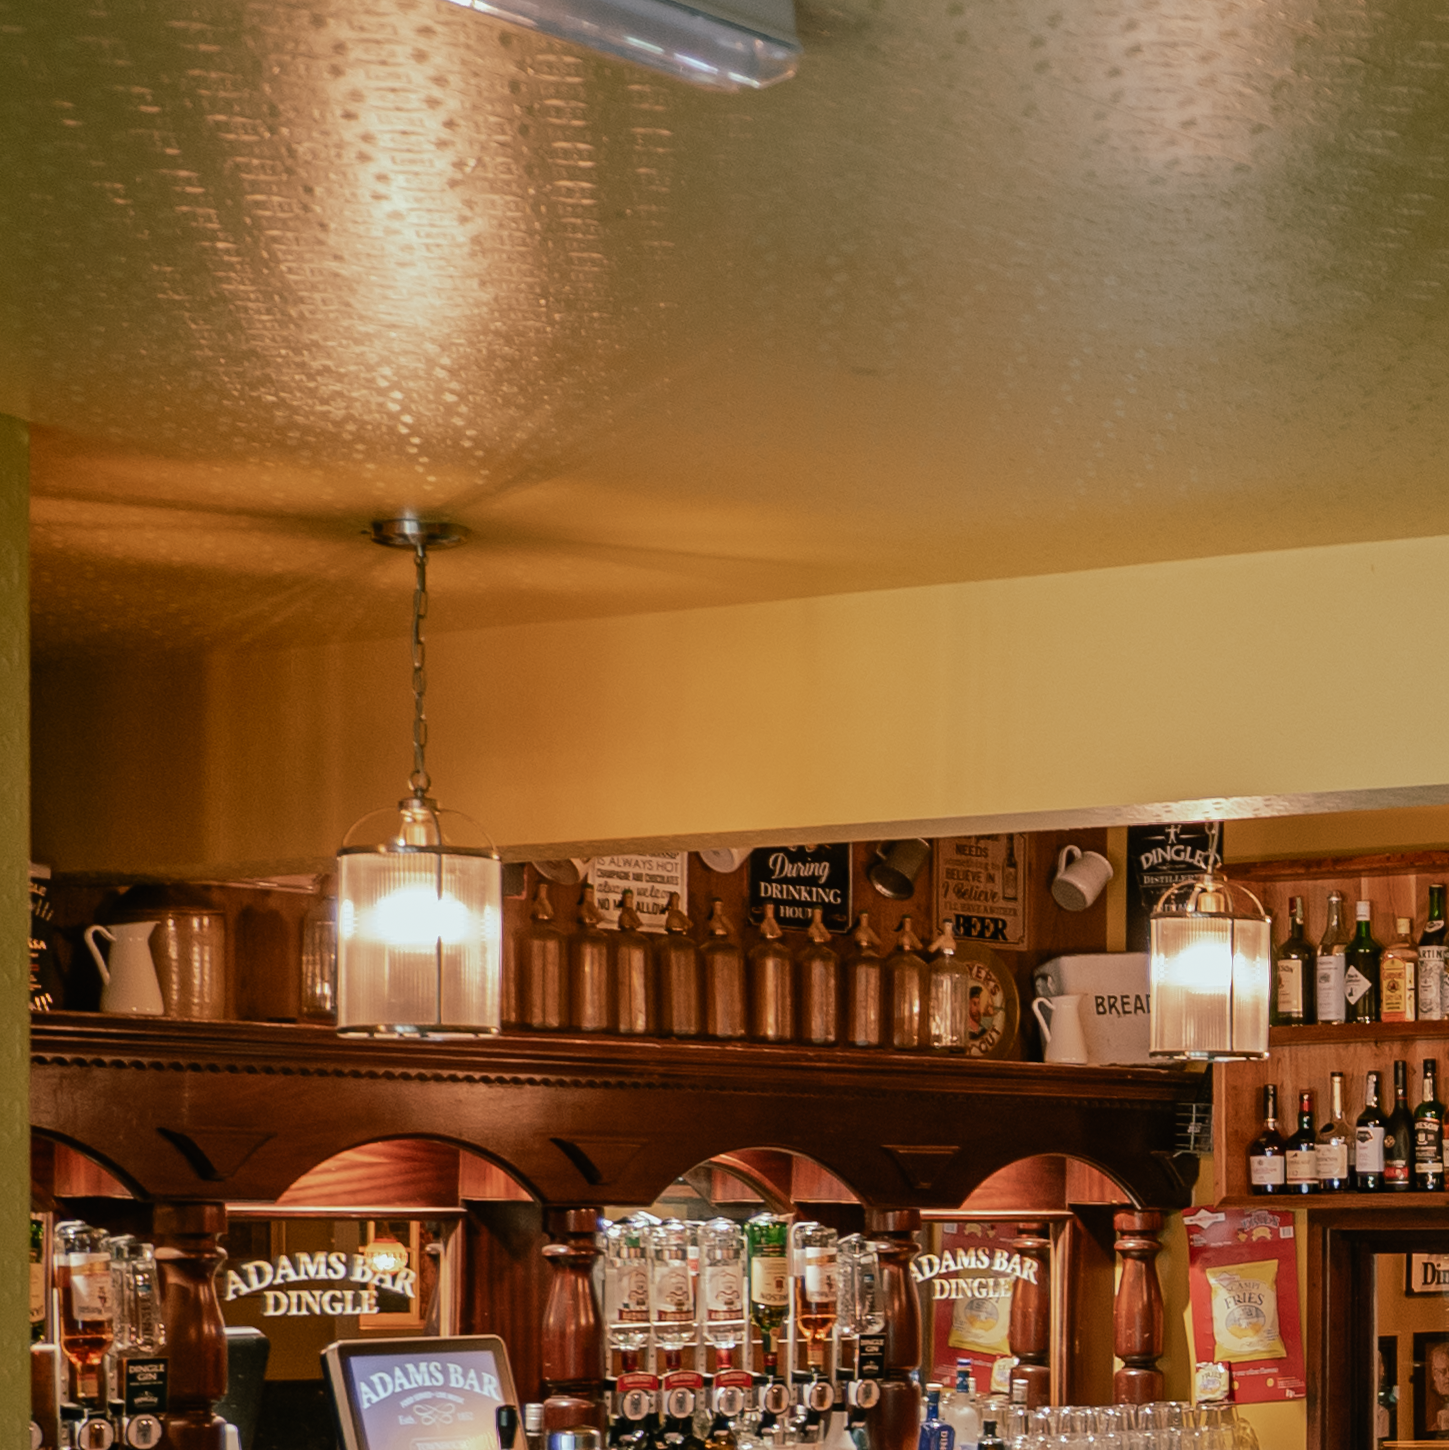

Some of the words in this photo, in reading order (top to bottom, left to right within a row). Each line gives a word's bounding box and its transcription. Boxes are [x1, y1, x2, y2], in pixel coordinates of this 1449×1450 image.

[608, 857, 653, 871] ALWAYS
[656, 861, 679, 873] HOT
[769, 852, 830, 884] During
[760, 881, 842, 905] DRINKING
[955, 914, 1008, 941] BEER
[1095, 994, 1150, 1016] BREA
[224, 1250, 347, 1301] ADAMS
[350, 1252, 416, 1298] BAR
[909, 1246, 989, 1284] ADAMS
[992, 1248, 1038, 1285] BAR
[932, 1278, 1013, 1300] DINGLE
[1223, 1292, 1265, 1310] FRIES
[262, 1290, 380, 1318] DINGLE
[359, 1361, 445, 1410] ADAMS
[447, 1362, 502, 1401] BAR
